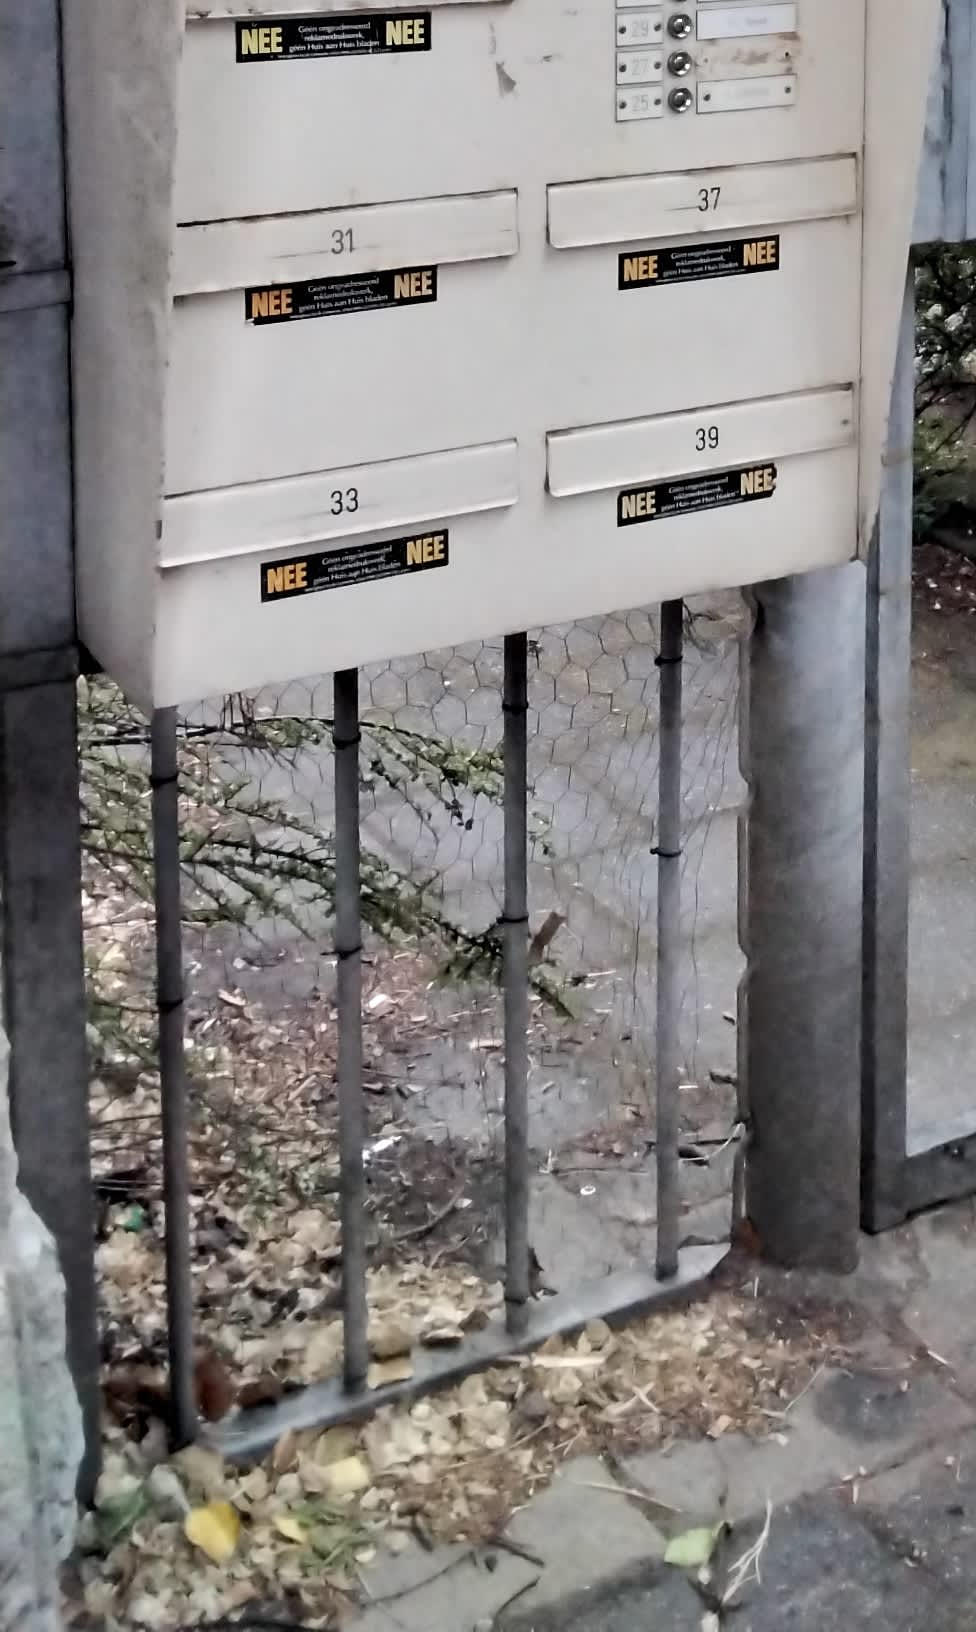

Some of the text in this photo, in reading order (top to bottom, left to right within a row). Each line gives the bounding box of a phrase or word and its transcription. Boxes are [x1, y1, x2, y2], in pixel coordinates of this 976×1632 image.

[241, 27, 283, 55] NEE
[385, 19, 425, 46] NEE
[631, 21, 649, 38] 29
[631, 94, 649, 112] 25
[698, 187, 721, 211] 37
[331, 227, 354, 254] 31
[743, 240, 776, 266] NEE
[623, 255, 658, 282] NEE
[394, 270, 433, 300] NEE
[251, 289, 293, 318] NEE
[695, 426, 719, 451] 39
[740, 468, 773, 496] NEE
[330, 488, 359, 515] 33
[621, 491, 656, 519] NEE
[406, 535, 445, 566] NEE
[266, 562, 308, 594] NEE
